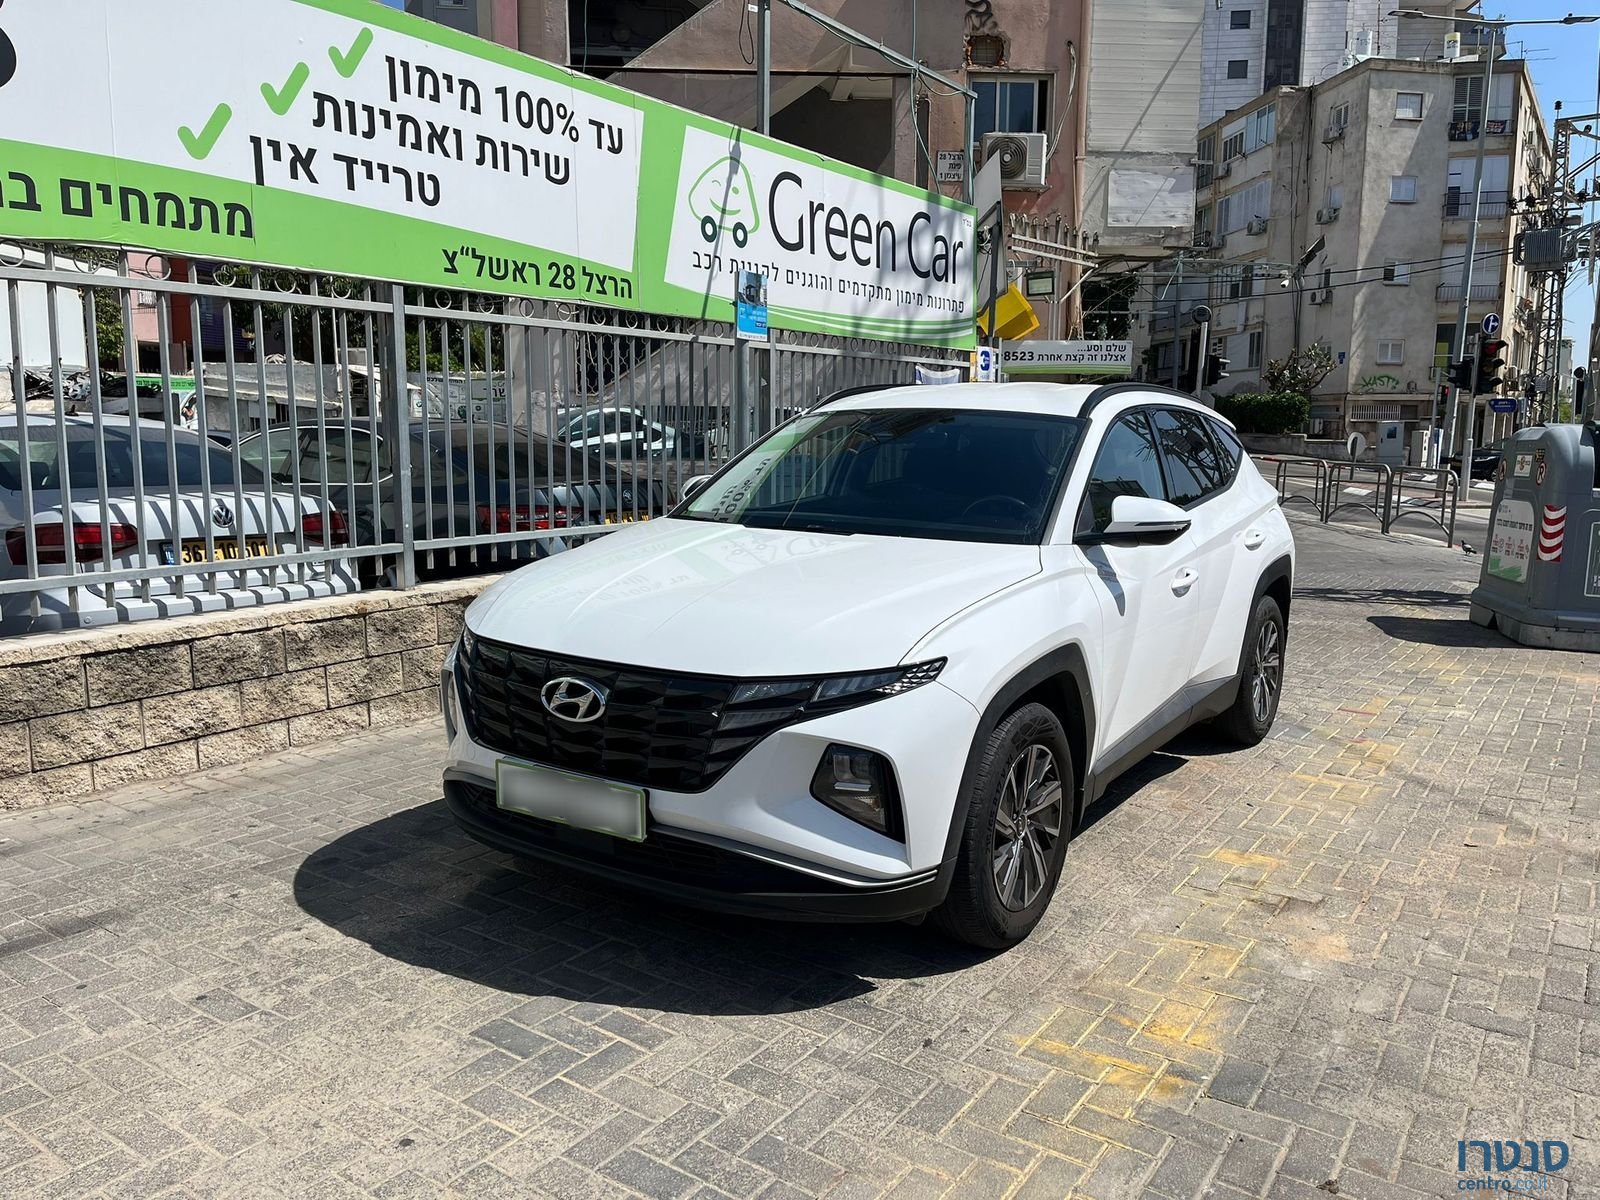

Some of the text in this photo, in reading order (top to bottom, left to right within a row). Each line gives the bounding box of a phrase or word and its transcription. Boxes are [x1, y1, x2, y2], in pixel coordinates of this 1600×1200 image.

[385, 54, 624, 155] עד 100% מימון
[312, 91, 570, 186] שירות ואמינות
[249, 135, 441, 207] טרייד אין
[0, 171, 254, 239] מתמחים ב
[768, 170, 963, 285] Green Car
[442, 245, 632, 299] הרצל 28 ראשל"צ
[692, 251, 722, 272] רכב
[786, 269, 832, 291] והוגנים
[839, 279, 892, 302] מתקדמים
[896, 289, 923, 306] מימון
[927, 295, 964, 313] פתרונות
[1037, 353, 1062, 361] אחרת
[1064, 353, 1085, 363] קצת
[1087, 353, 1098, 361] זה
[1100, 353, 1126, 361] אצלנו
[1105, 343, 1127, 352] שלם
